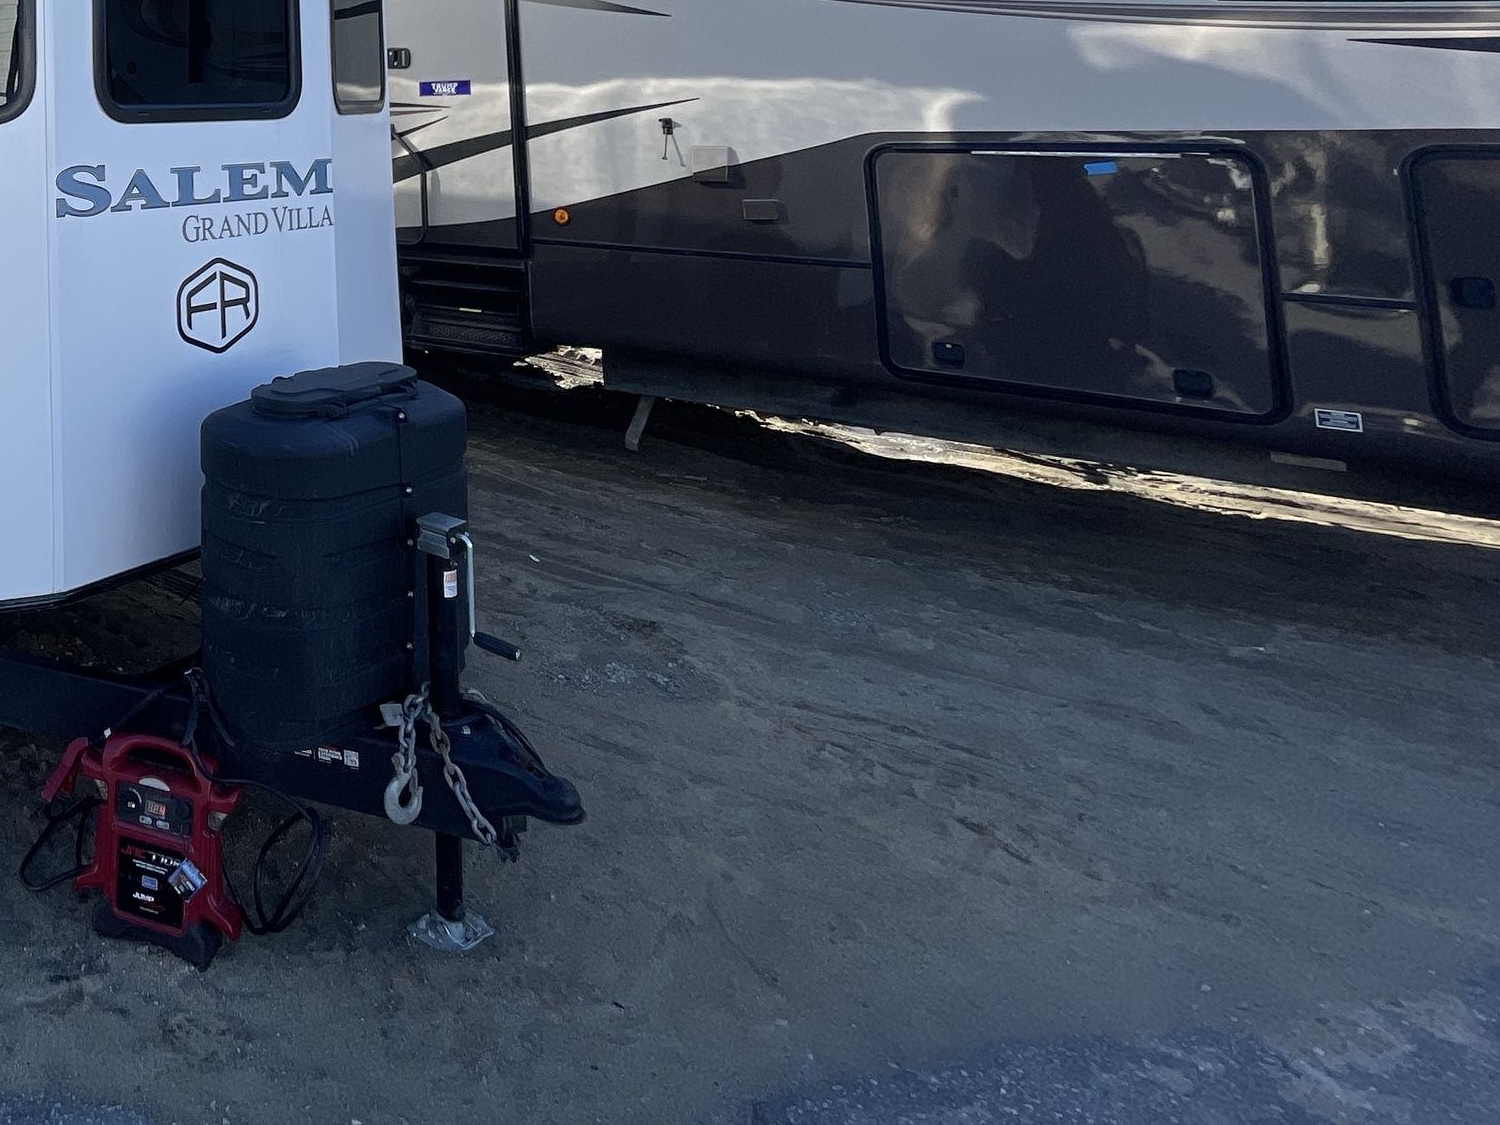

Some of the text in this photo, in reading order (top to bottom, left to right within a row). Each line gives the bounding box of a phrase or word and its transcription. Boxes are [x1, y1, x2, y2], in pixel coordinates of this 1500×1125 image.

[55, 158, 334, 219] SALEM
[182, 205, 334, 243] GRAND VILLA
